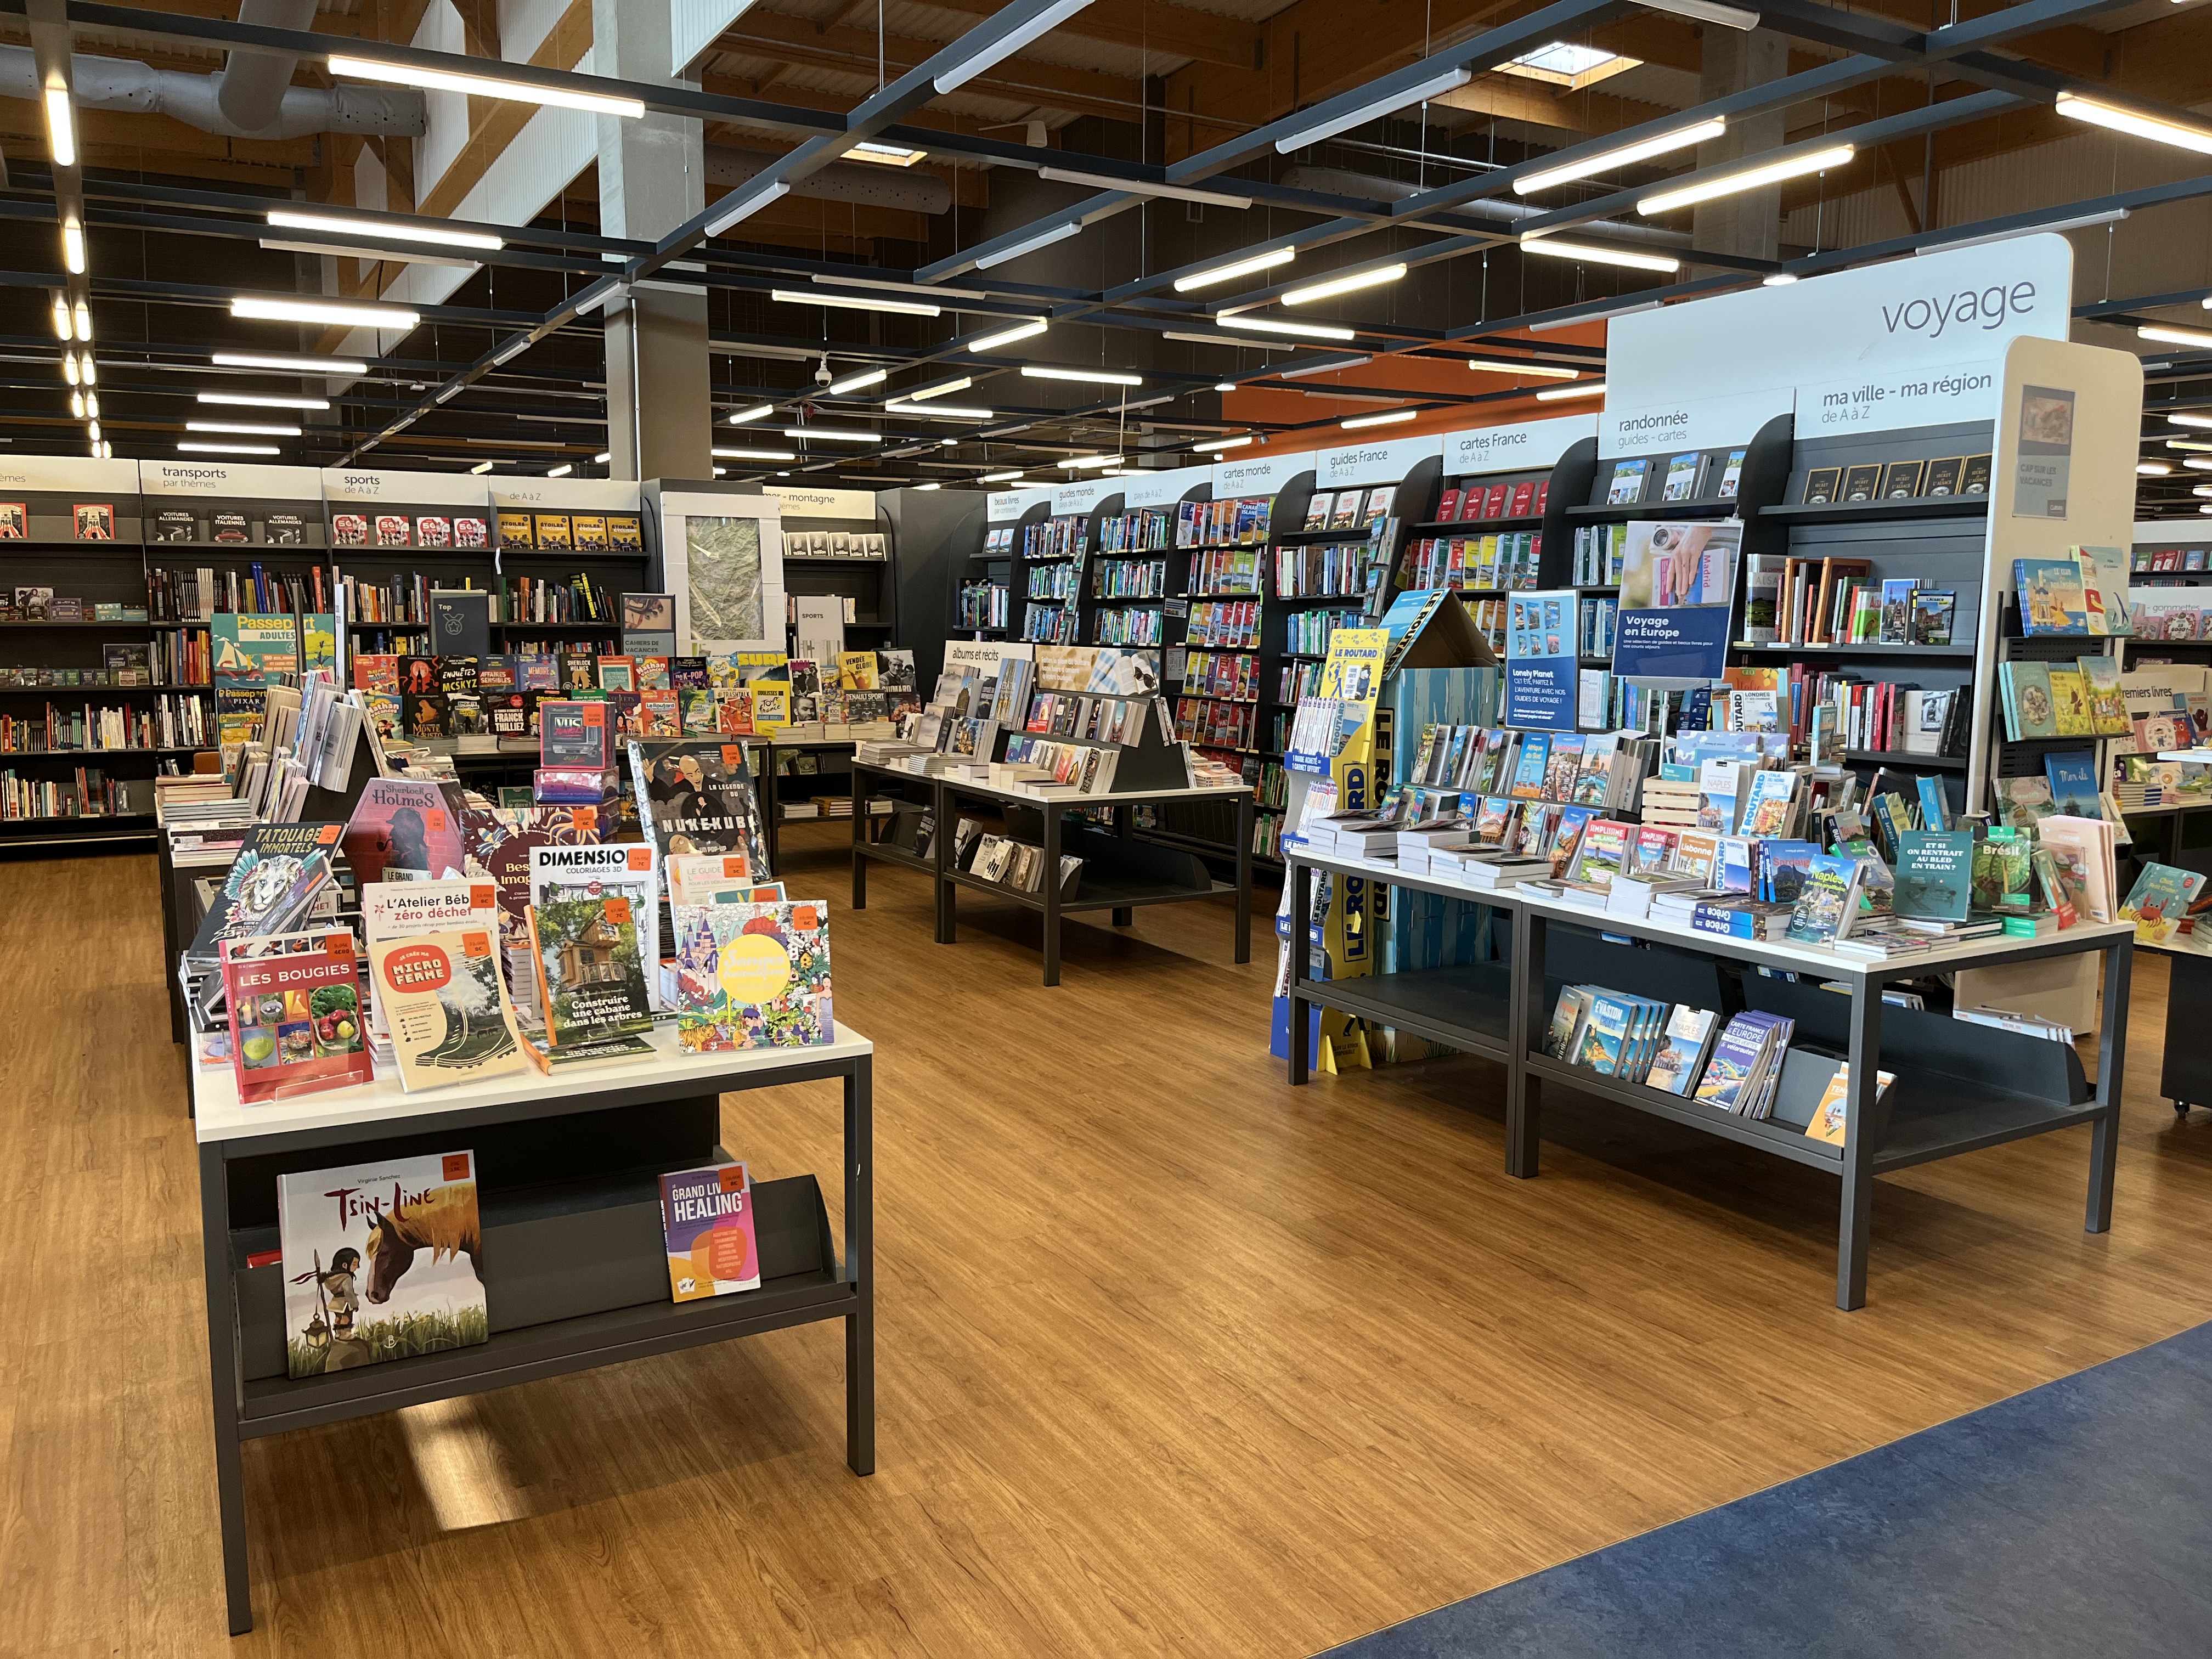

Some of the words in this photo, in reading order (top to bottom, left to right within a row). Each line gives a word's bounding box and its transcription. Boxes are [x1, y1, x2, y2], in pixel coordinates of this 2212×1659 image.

[1882, 280, 2035, 338] voyage
[1823, 391, 1848, 407] ma
[1853, 385, 1884, 404] ville
[1901, 382, 1928, 397] ma
[1933, 373, 1991, 393] région
[1619, 410, 1688, 431] randonnée
[1822, 408, 1837, 424] de
[1840, 407, 1849, 421] A
[1852, 407, 1858, 420] à
[1861, 405, 1870, 418] Z
[1460, 437, 1489, 450] cartes
[1492, 432, 1527, 446] France
[1330, 453, 1357, 467] guides
[1359, 449, 1387, 461] France
[1460, 454, 1469, 463] de
[1470, 453, 1476, 462] A
[1477, 452, 1482, 461] à
[1483, 451, 1489, 461] Z
[163, 467, 227, 479] transports
[1224, 469, 1244, 478] cartes
[1245, 464, 1271, 476] monde
[180, 479, 216, 488] thèmes
[345, 475, 380, 486] sports
[2020, 477, 2052, 487] VACANCES
[1059, 489, 1075, 501] guides
[1076, 486, 1094, 496] monde
[995, 497, 1007, 505] beaux
[1008, 496, 1019, 505] livres
[1425, 592, 1442, 608] LE
[2153, 605, 2199, 613] gommettes
[1626, 616, 1669, 628] Voyage
[1641, 628, 1679, 639] Europe
[1383, 611, 1429, 675] ROUTARD
[738, 653, 787, 665] SURF
[953, 647, 974, 659] albums
[975, 650, 981, 660] et
[982, 649, 998, 661] récits
[1344, 649, 1377, 658] ROUTARD
[846, 655, 865, 665] VENDÉE
[856, 662, 872, 670] GLOBE
[443, 668, 476, 679] ENQUÊTES
[528, 667, 549, 675] MÉMOIRE
[636, 662, 665, 674] Nathan
[1513, 669, 1532, 678] Lonely
[684, 672, 703, 680] K-POP
[443, 679, 477, 692] MCSKYZ
[2152, 686, 2172, 697] livres
[495, 713, 523, 723] FRANCK
[495, 723, 524, 731] THILLIEZ
[1585, 746, 1611, 756] Londres
[1294, 763, 1307, 771] CARNET
[386, 785, 424, 795] Sherlock
[1707, 780, 1731, 788] NAPLES
[1746, 774, 1766, 826] ROUTARD
[1590, 824, 1623, 837] SIMPLISSIME
[1594, 835, 1617, 843] IRLANDE
[259, 842, 313, 854] IMMORTELS
[1681, 843, 1712, 856] Lisbonne
[1983, 845, 2019, 856] Brésil
[539, 849, 630, 867] DIMENSIO
[506, 863, 529, 872] Bes
[566, 866, 610, 874] COLORIAGES
[387, 871, 397, 881] LE
[398, 872, 413, 881] GRAND
[1812, 870, 1843, 884] Naples
[387, 896, 440, 910] L'Atelier
[445, 894, 469, 906] Béb
[394, 910, 423, 921] zéro
[428, 907, 472, 918] déchet
[1707, 907, 1730, 921] Grèce
[1706, 919, 1730, 933] Grèce
[392, 959, 442, 976] MICRO
[240, 973, 272, 986] LES
[278, 964, 350, 982] BOUGIES
[396, 970, 444, 986] FERME
[572, 995, 629, 1009] Construire
[572, 1009, 591, 1018] une
[593, 1004, 631, 1014] cabane
[1594, 1000, 1623, 1020] ÉVASION
[563, 1019, 589, 1028] dans
[591, 1015, 606, 1025] les
[607, 1011, 642, 1022] arbres
[1674, 1024, 1699, 1035] NAPLES
[1730, 1020, 1744, 1031] CARTE
[1745, 1024, 1765, 1035] FRANCE
[1733, 1028, 1762, 1042] EUROPE
[1727, 1043, 1756, 1056] véloroutes
[357, 1176, 378, 1184] Virginie
[672, 1184, 705, 1201] GRAND
[674, 1192, 742, 1222] HEALING
